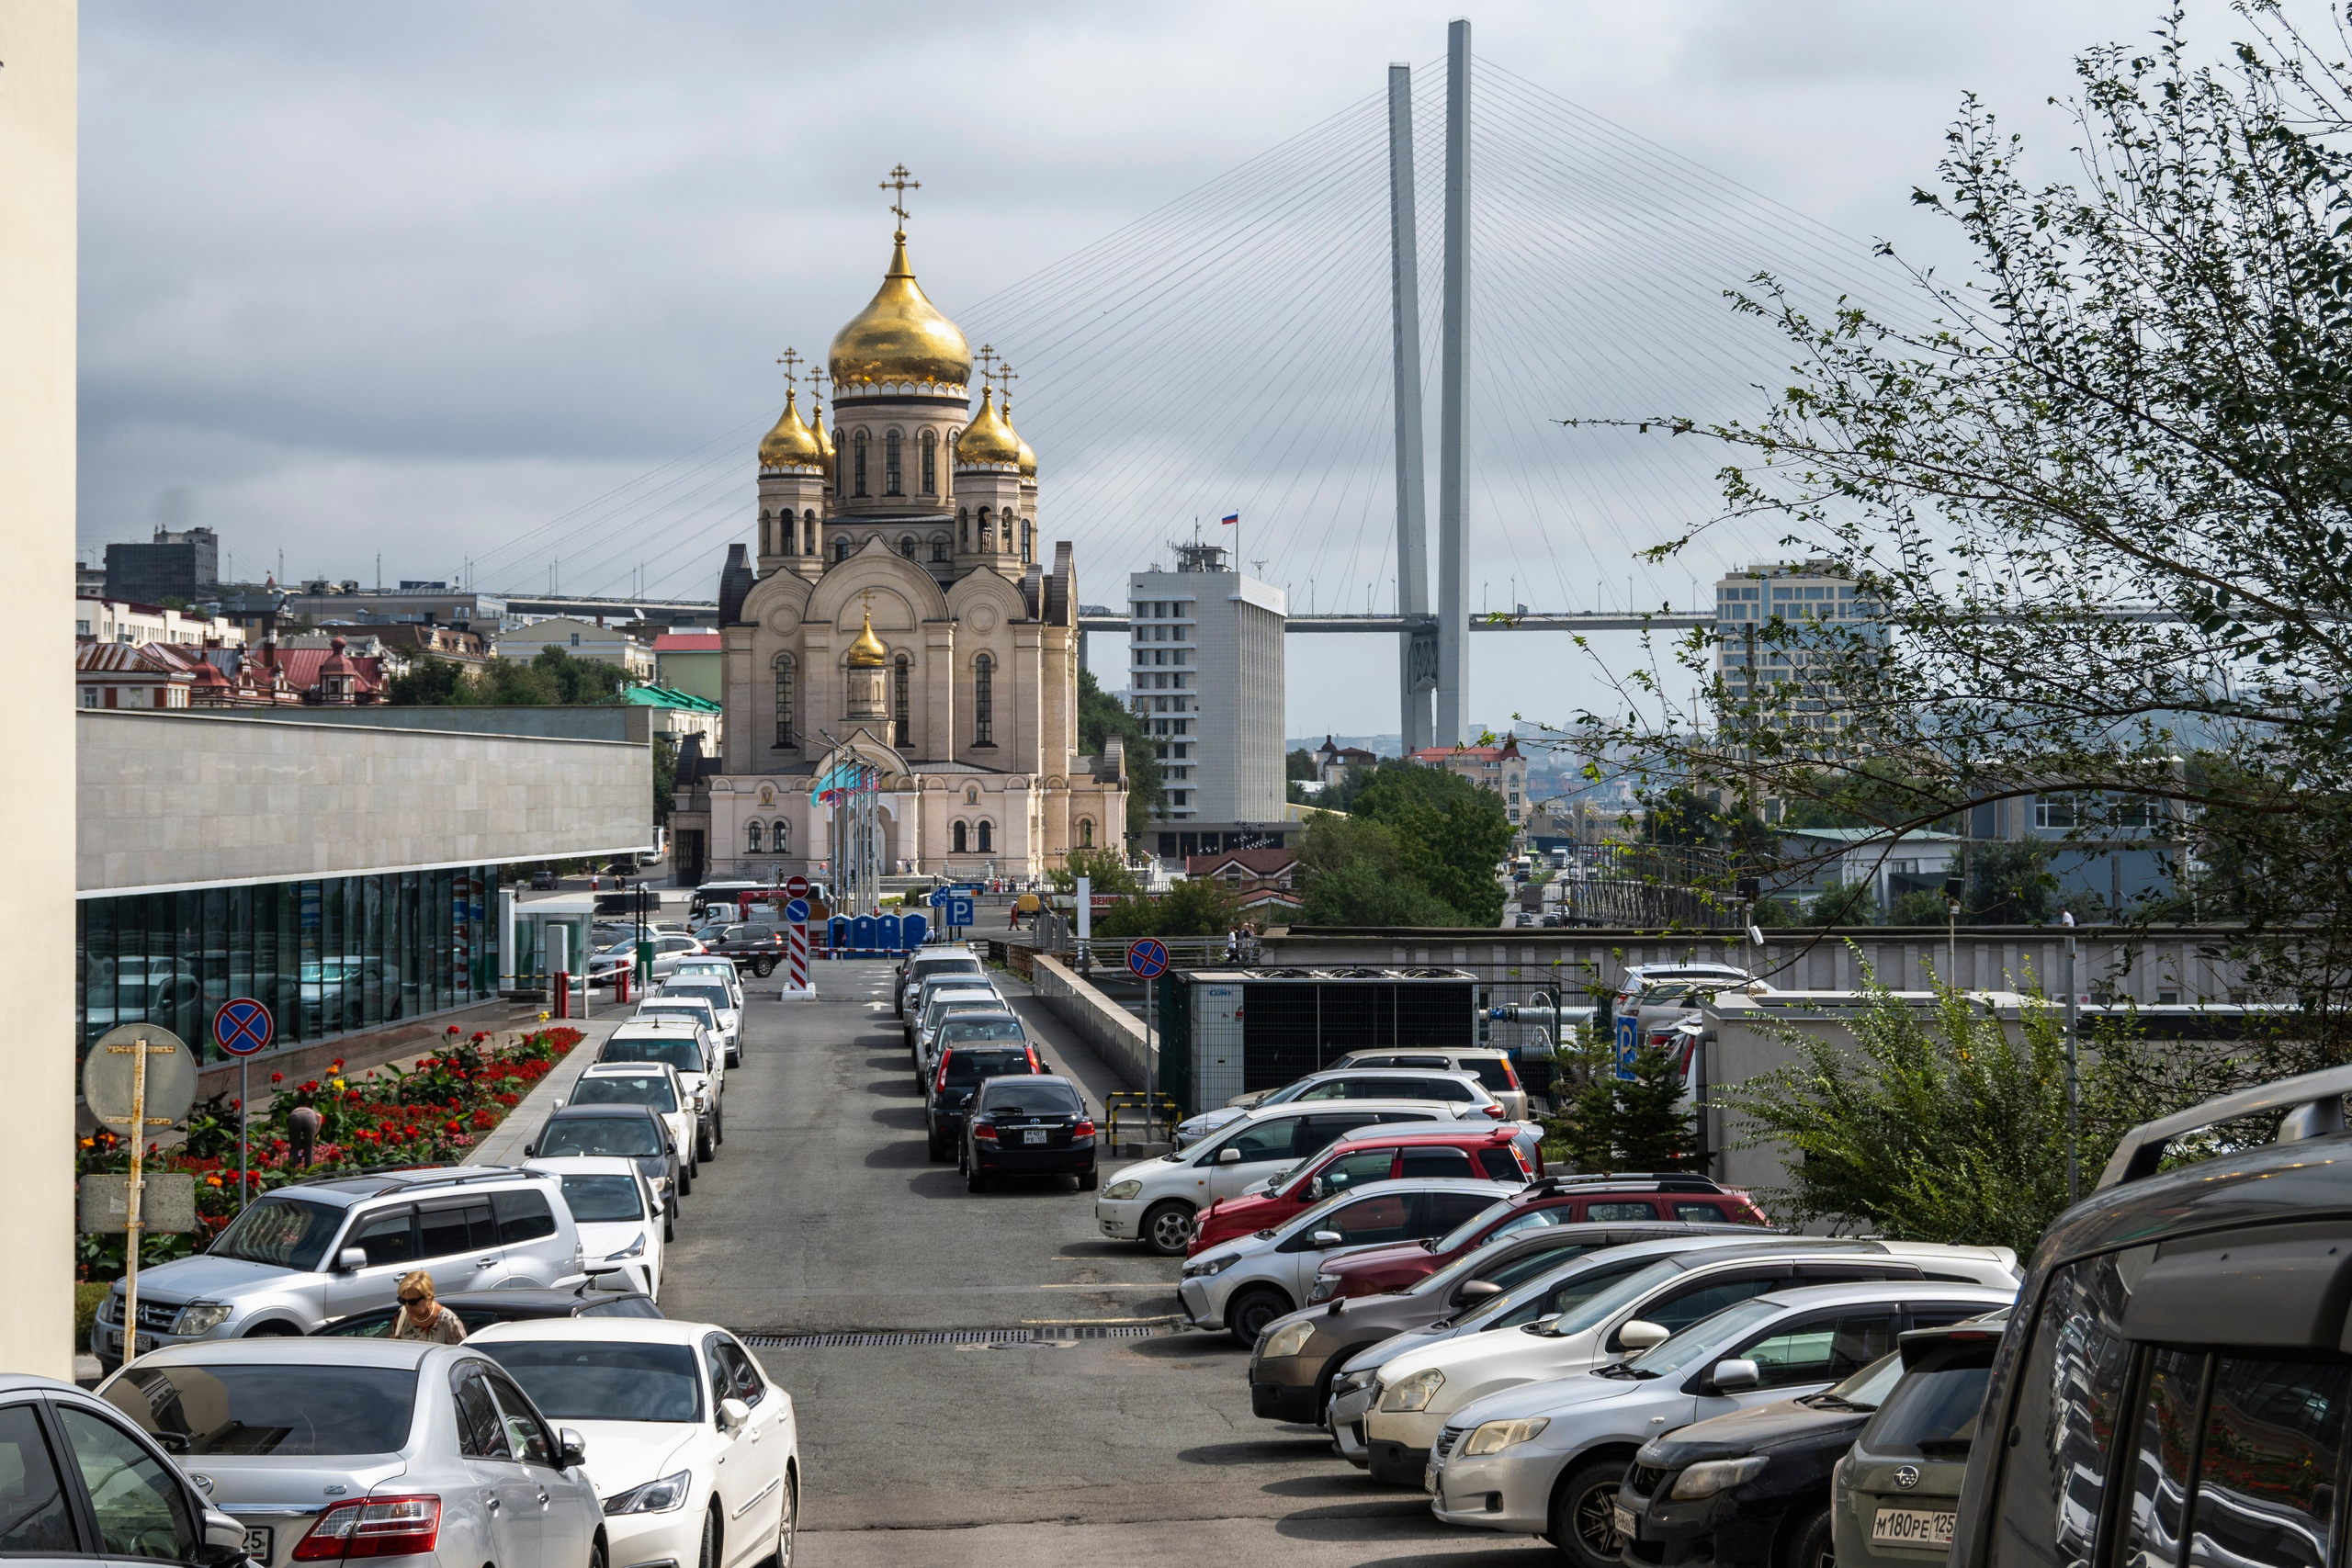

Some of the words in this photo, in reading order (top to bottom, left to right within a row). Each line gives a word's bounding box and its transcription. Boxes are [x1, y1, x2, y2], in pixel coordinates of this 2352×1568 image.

[954, 901, 968, 923] P
[1620, 1024, 1633, 1072] P
[1934, 1514, 1955, 1533] 125
